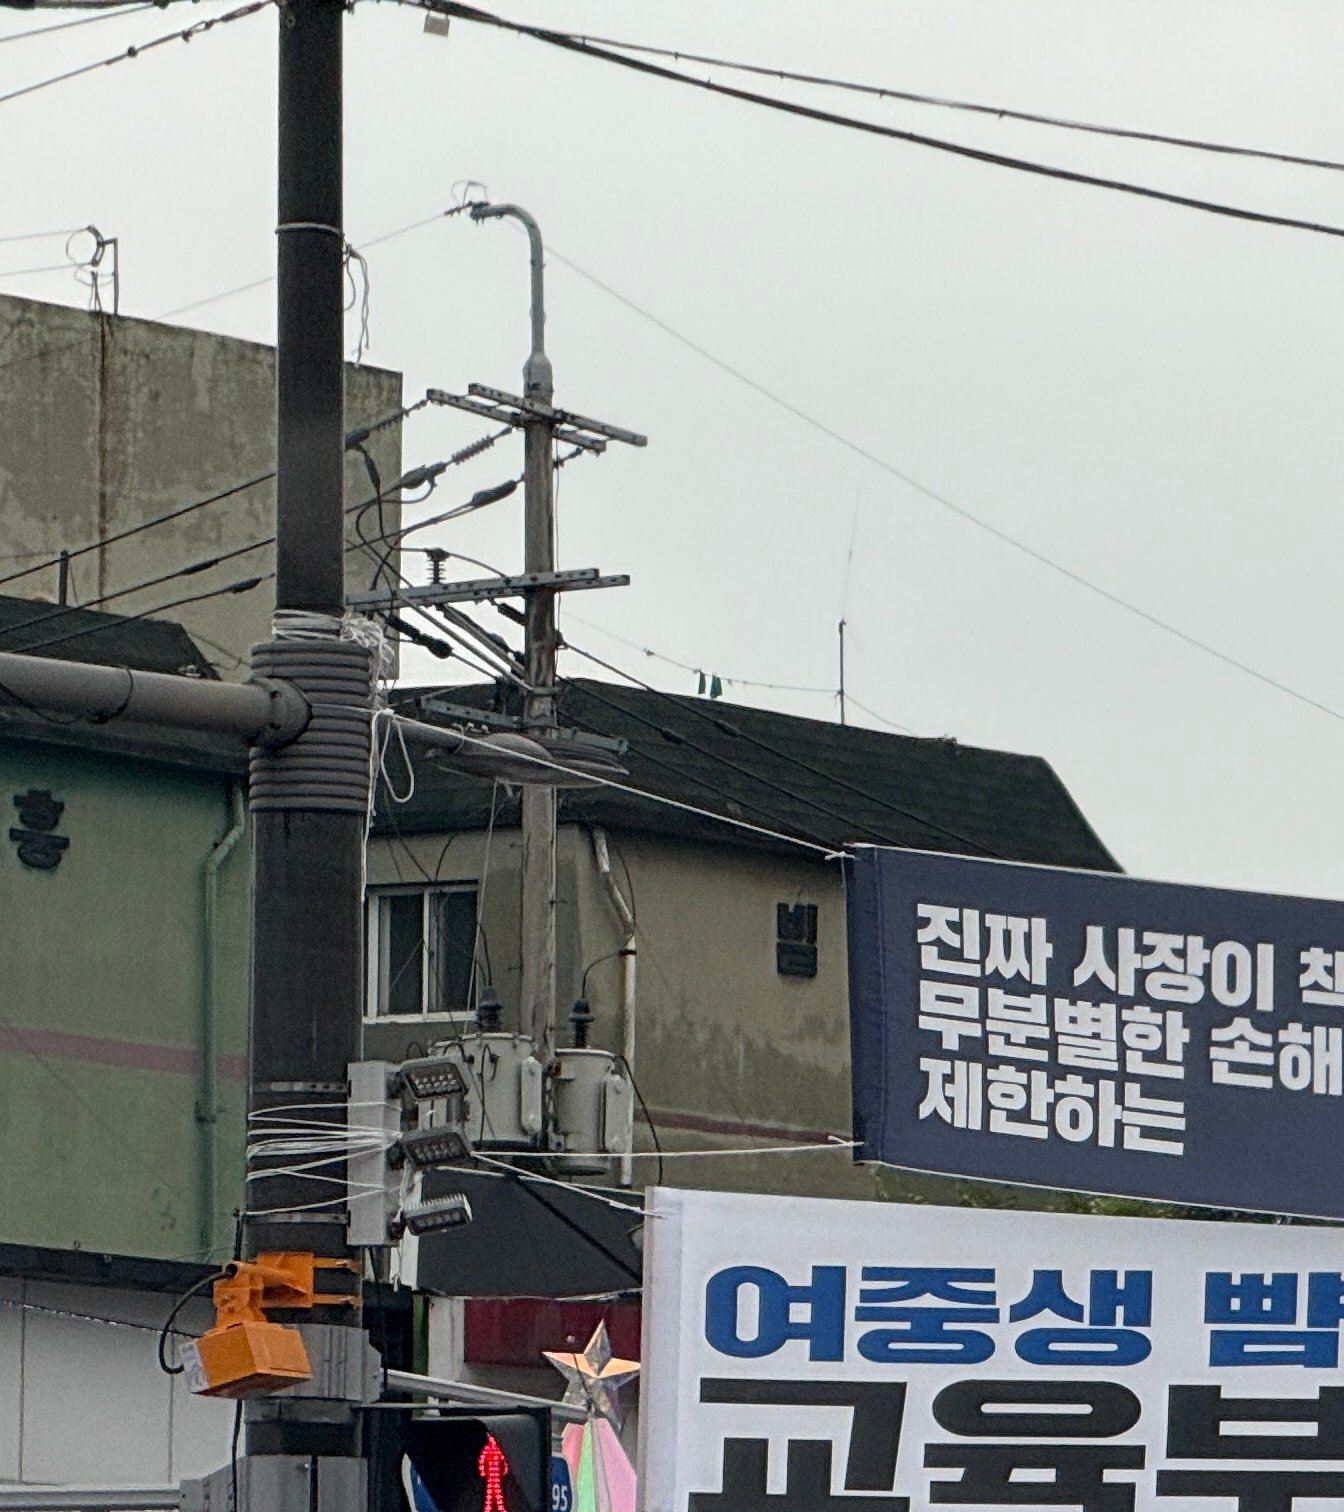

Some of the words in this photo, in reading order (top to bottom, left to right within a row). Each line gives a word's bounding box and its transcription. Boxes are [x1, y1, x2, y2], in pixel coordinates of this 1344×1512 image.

[915, 902, 1052, 986] 진짜
[1072, 924, 1274, 1014] 사장이
[915, 978, 1190, 1079] 무분별한
[918, 1053, 1186, 1156] 제한하는
[703, 1263, 1155, 1368] 여중생
